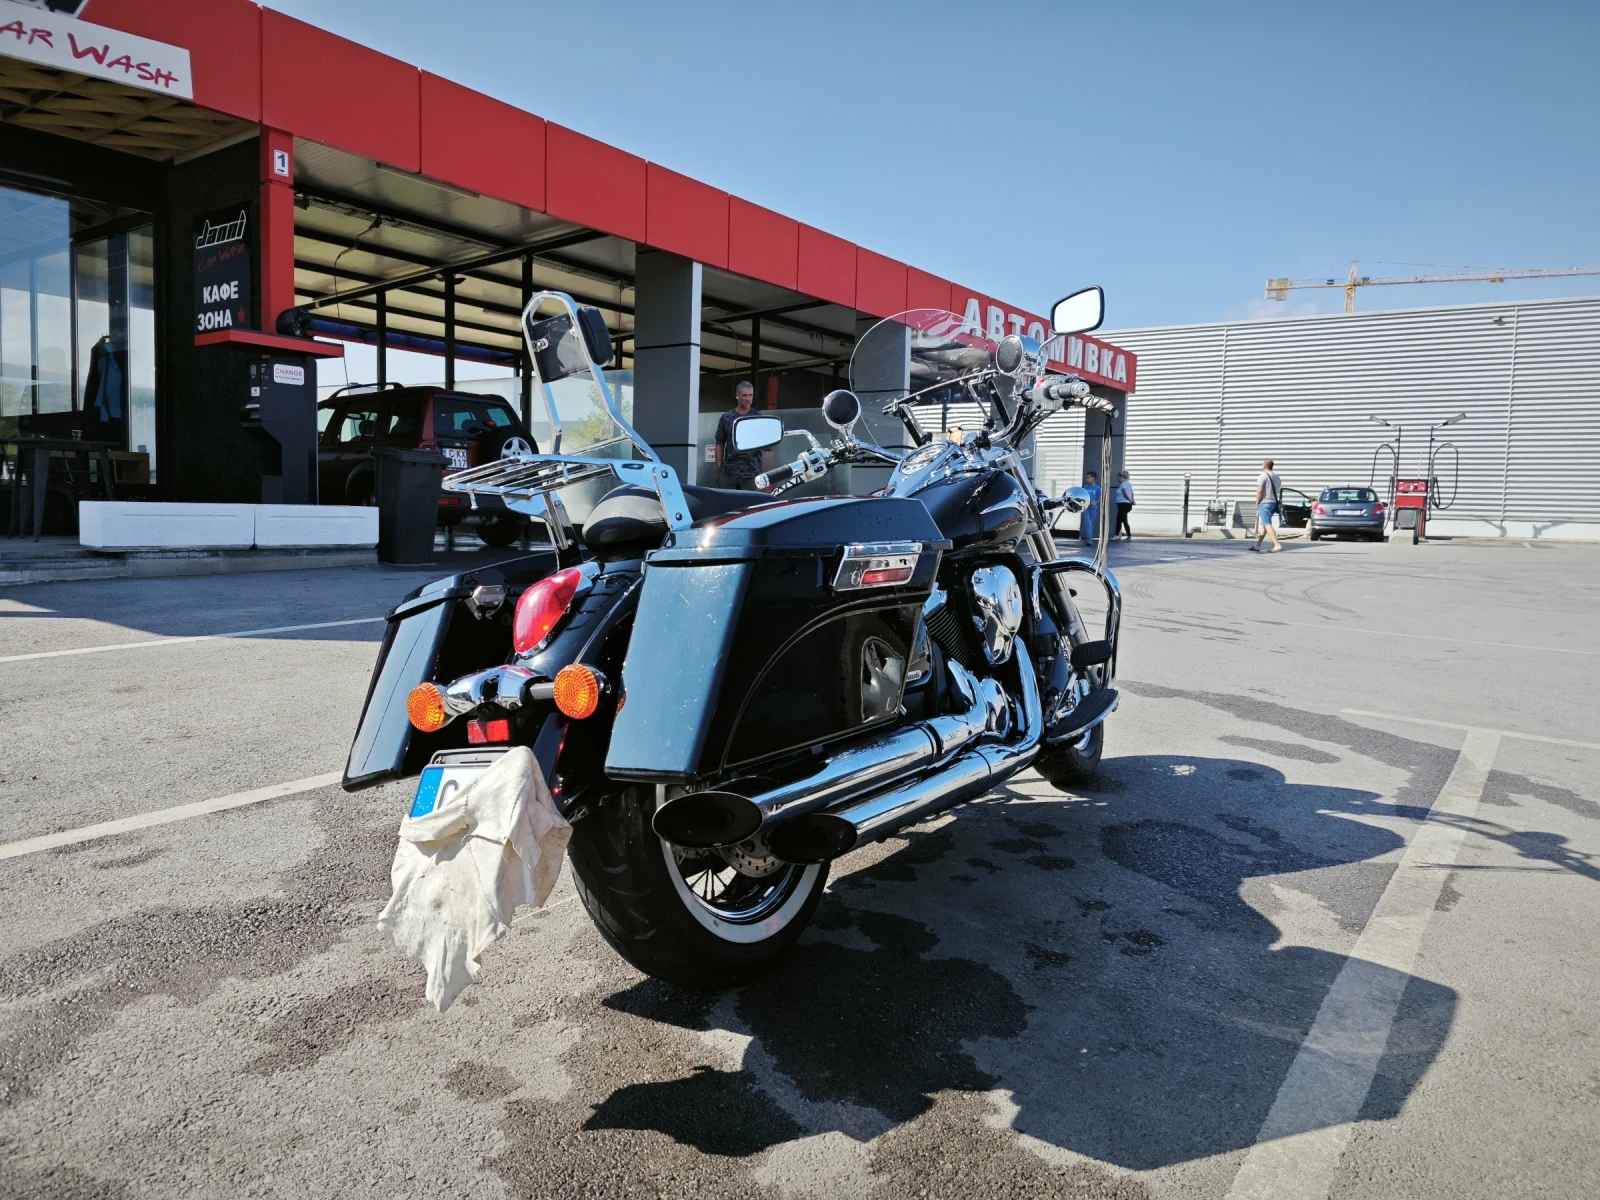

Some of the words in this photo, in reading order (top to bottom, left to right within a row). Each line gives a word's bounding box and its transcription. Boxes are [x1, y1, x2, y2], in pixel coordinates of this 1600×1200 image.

[67, 32, 179, 89] WASH
[277, 153, 286, 168] 1
[203, 280, 239, 304] КАФЕ
[197, 308, 233, 331] ЗОНА
[275, 368, 303, 377] CHANGE
